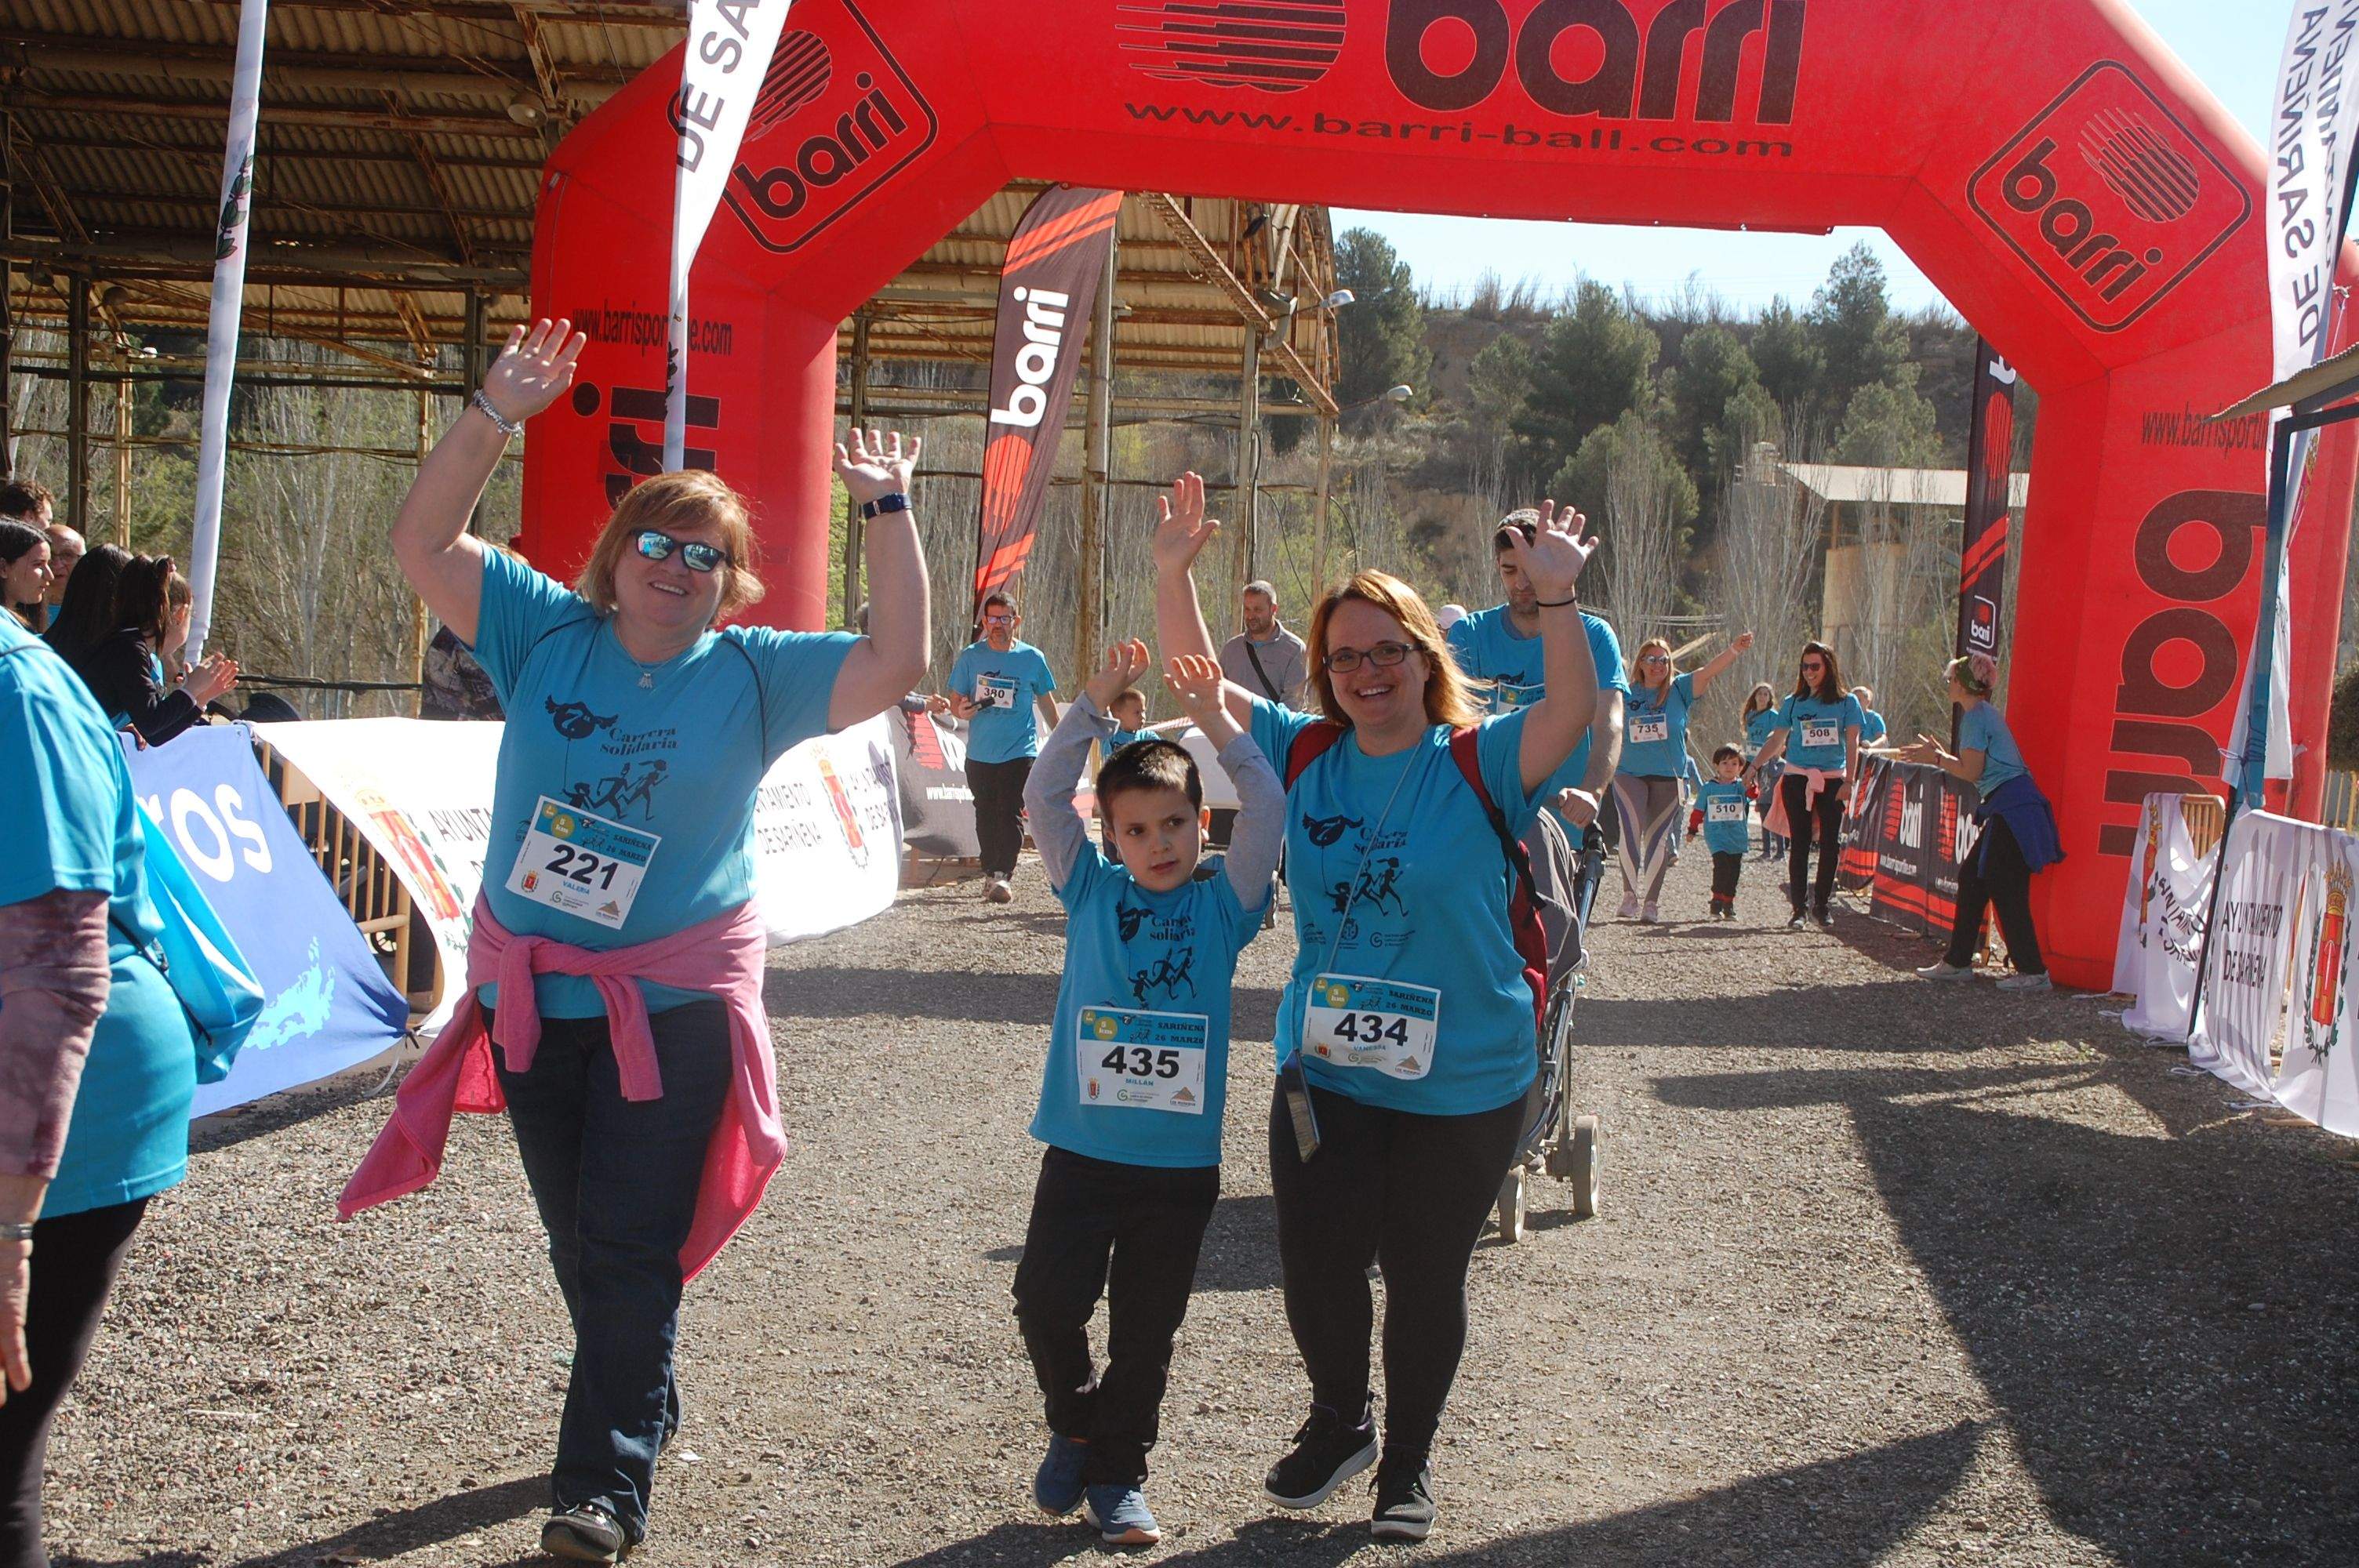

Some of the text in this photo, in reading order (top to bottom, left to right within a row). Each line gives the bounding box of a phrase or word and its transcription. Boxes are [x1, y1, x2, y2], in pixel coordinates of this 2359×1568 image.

[676, 82, 725, 173] DE
[1124, 102, 1794, 158] www.barri-ball.com
[732, 71, 908, 220] barri
[2001, 136, 2163, 305] barri
[990, 286, 1069, 427] barri
[983, 687, 1005, 699] 380
[609, 727, 677, 743] Carrera
[1637, 724, 1659, 733] 735
[1809, 728, 1830, 738] 508
[1716, 804, 1736, 813] 510
[544, 844, 620, 891] 221
[1400, 1004, 1433, 1017] MARZO
[1333, 1012, 1408, 1047] 434
[1101, 1045, 1180, 1079] 435
